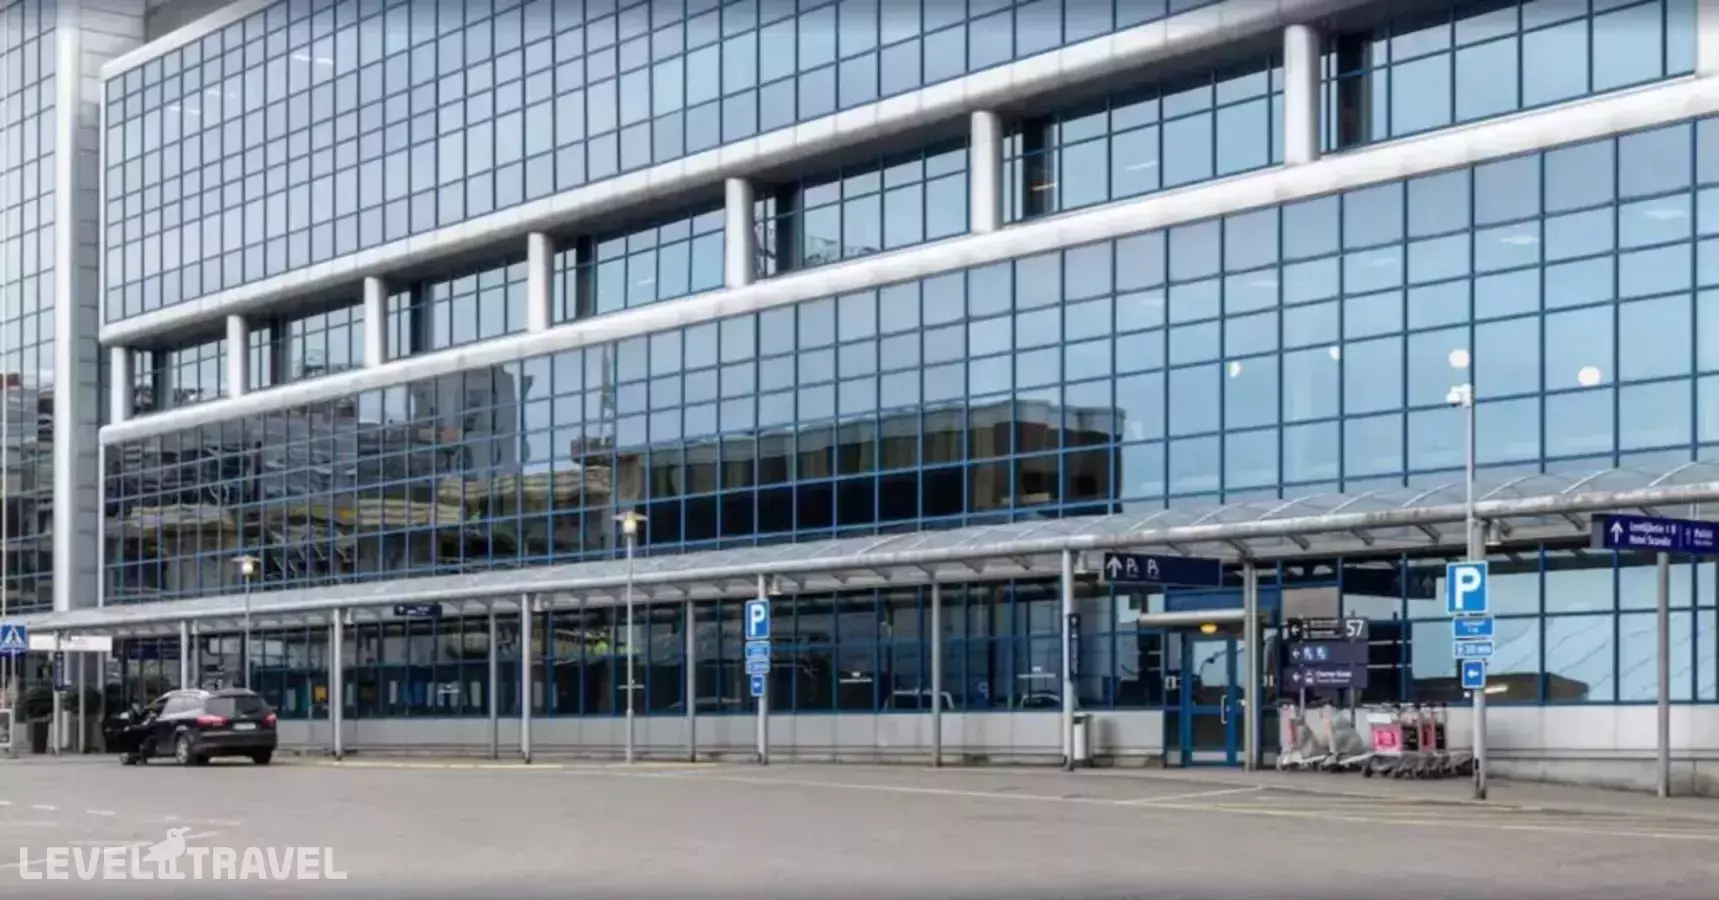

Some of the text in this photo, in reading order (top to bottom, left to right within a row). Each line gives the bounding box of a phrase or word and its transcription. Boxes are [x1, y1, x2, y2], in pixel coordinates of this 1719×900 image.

[1454, 566, 1482, 610] P
[750, 603, 765, 636] P
[1345, 619, 1364, 637] 57
